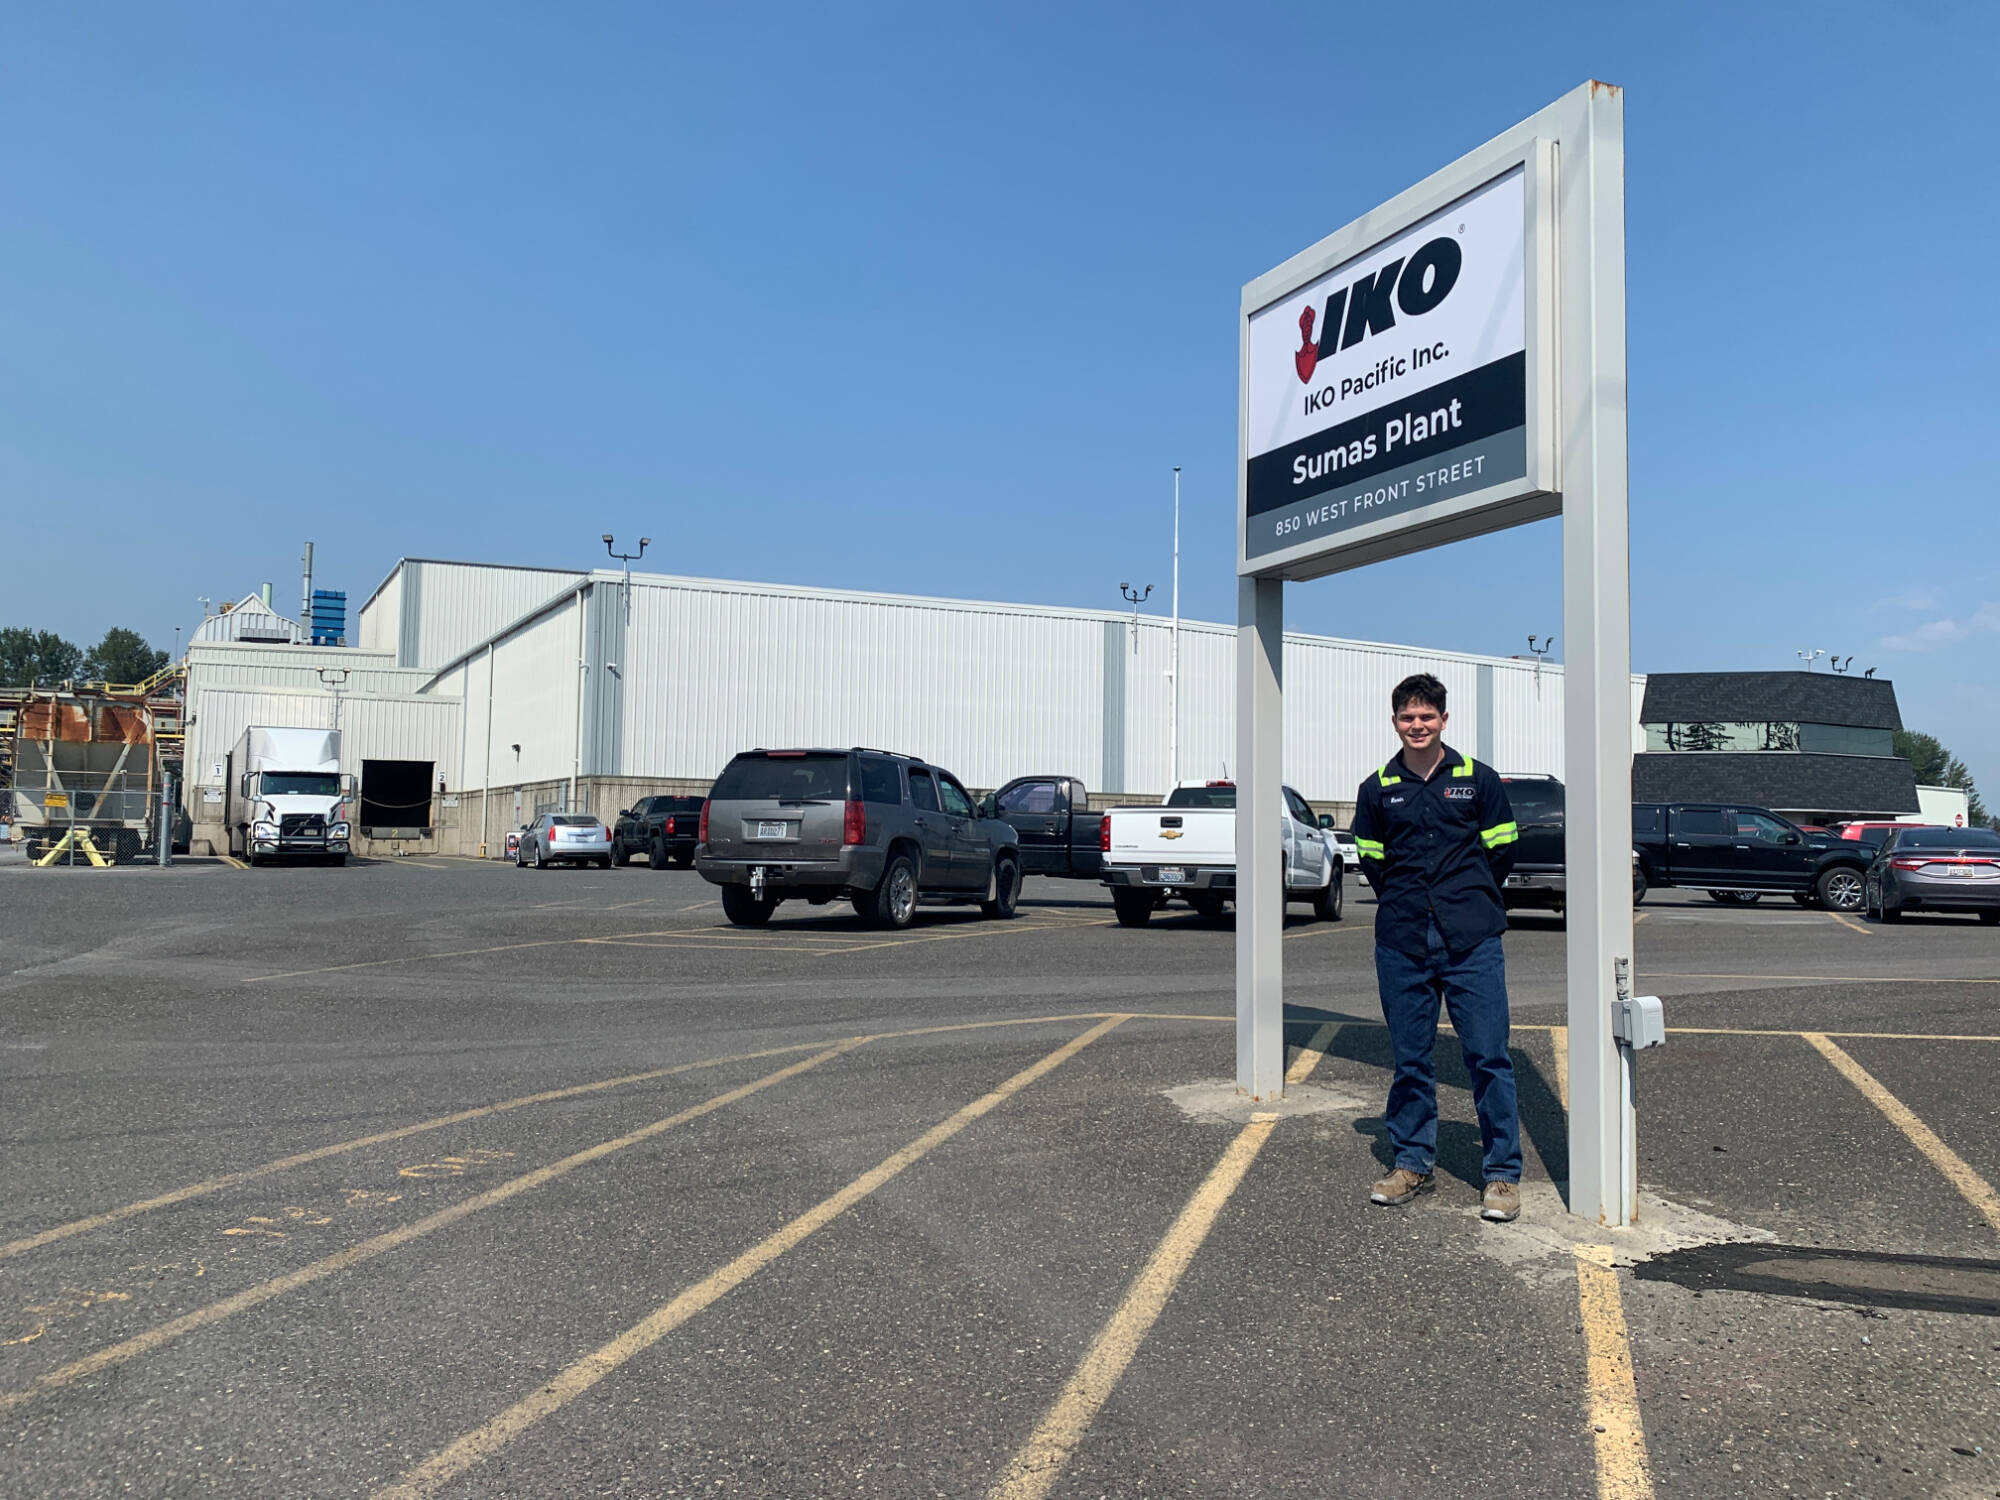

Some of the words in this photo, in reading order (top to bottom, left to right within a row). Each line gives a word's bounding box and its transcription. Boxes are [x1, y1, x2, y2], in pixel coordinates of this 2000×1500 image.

[1316, 237, 1462, 362] IKO
[1304, 386, 1335, 415] IKO
[1341, 356, 1406, 400] Pacific
[1412, 342, 1449, 370] Inc.
[1293, 434, 1377, 484] Sumas
[1385, 398, 1463, 452] Plant
[1276, 516, 1299, 536] 850
[1306, 501, 1348, 526] WEST
[1354, 480, 1409, 512] FRONT
[1416, 456, 1485, 492] STREET
